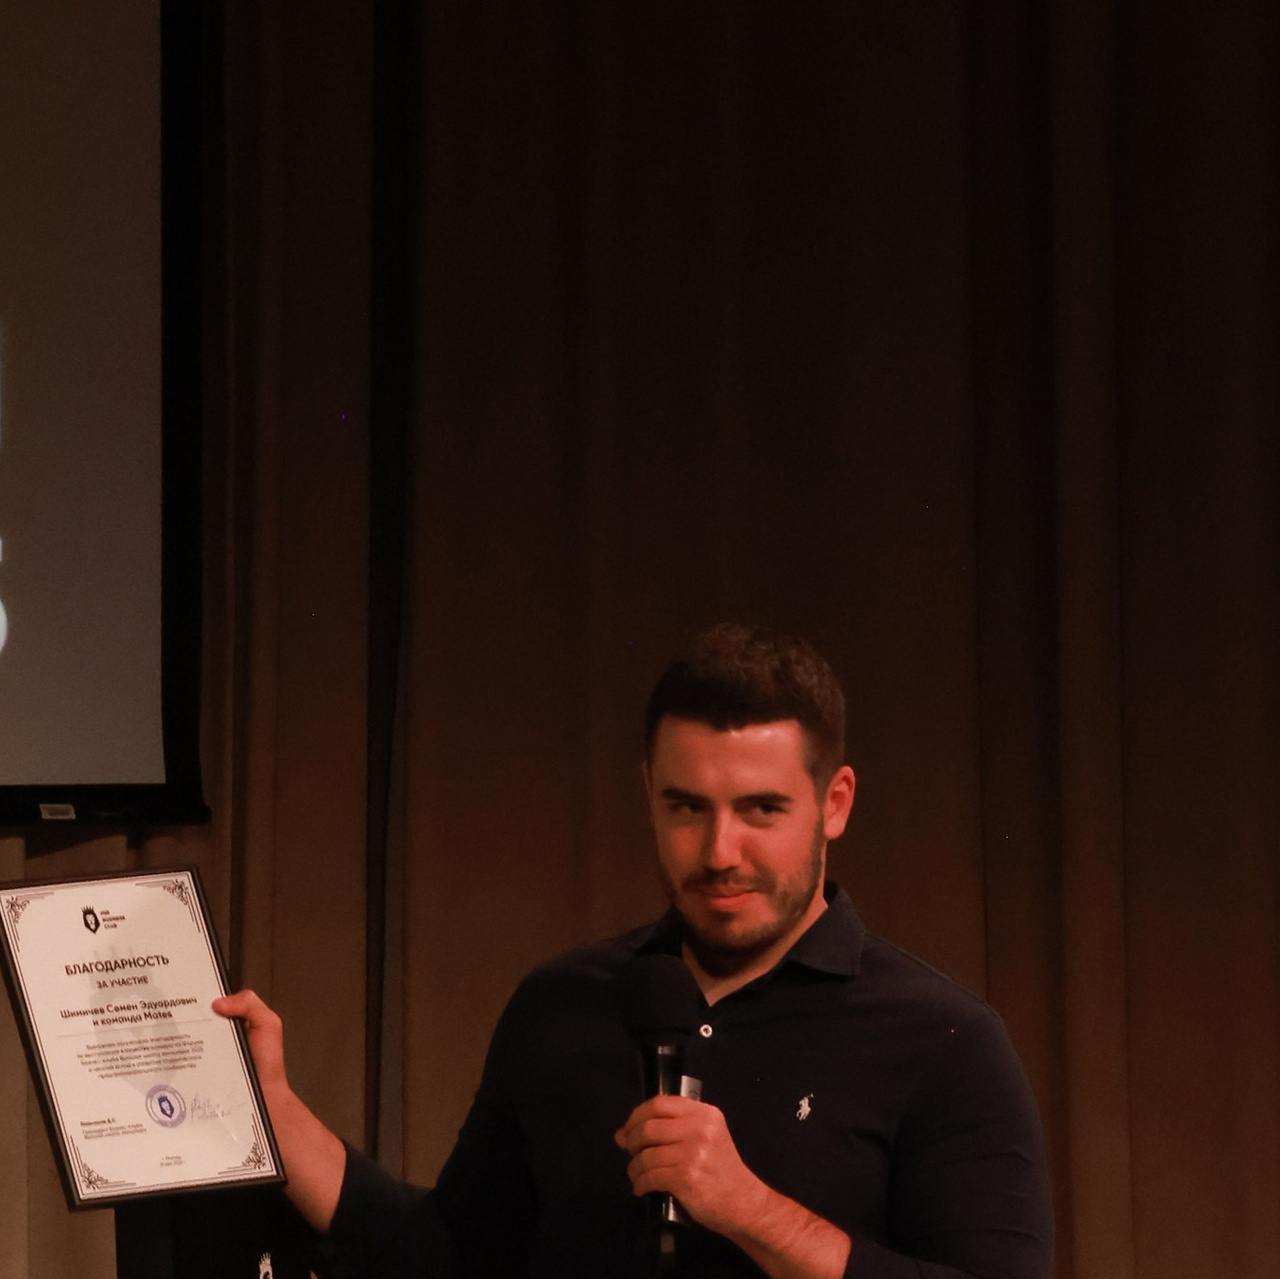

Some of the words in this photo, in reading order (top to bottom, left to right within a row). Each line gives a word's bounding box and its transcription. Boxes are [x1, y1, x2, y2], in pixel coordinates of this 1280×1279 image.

[65, 954, 169, 975] БЛАГОДАРНОСТЬ
[96, 980, 108, 989] ЗА
[110, 975, 148, 988] УЧАСТИЕ
[106, 1002, 138, 1013] Семен
[139, 997, 198, 1010] Эдуардович
[101, 1015, 142, 1025] команда
[144, 1010, 173, 1020] Mates
